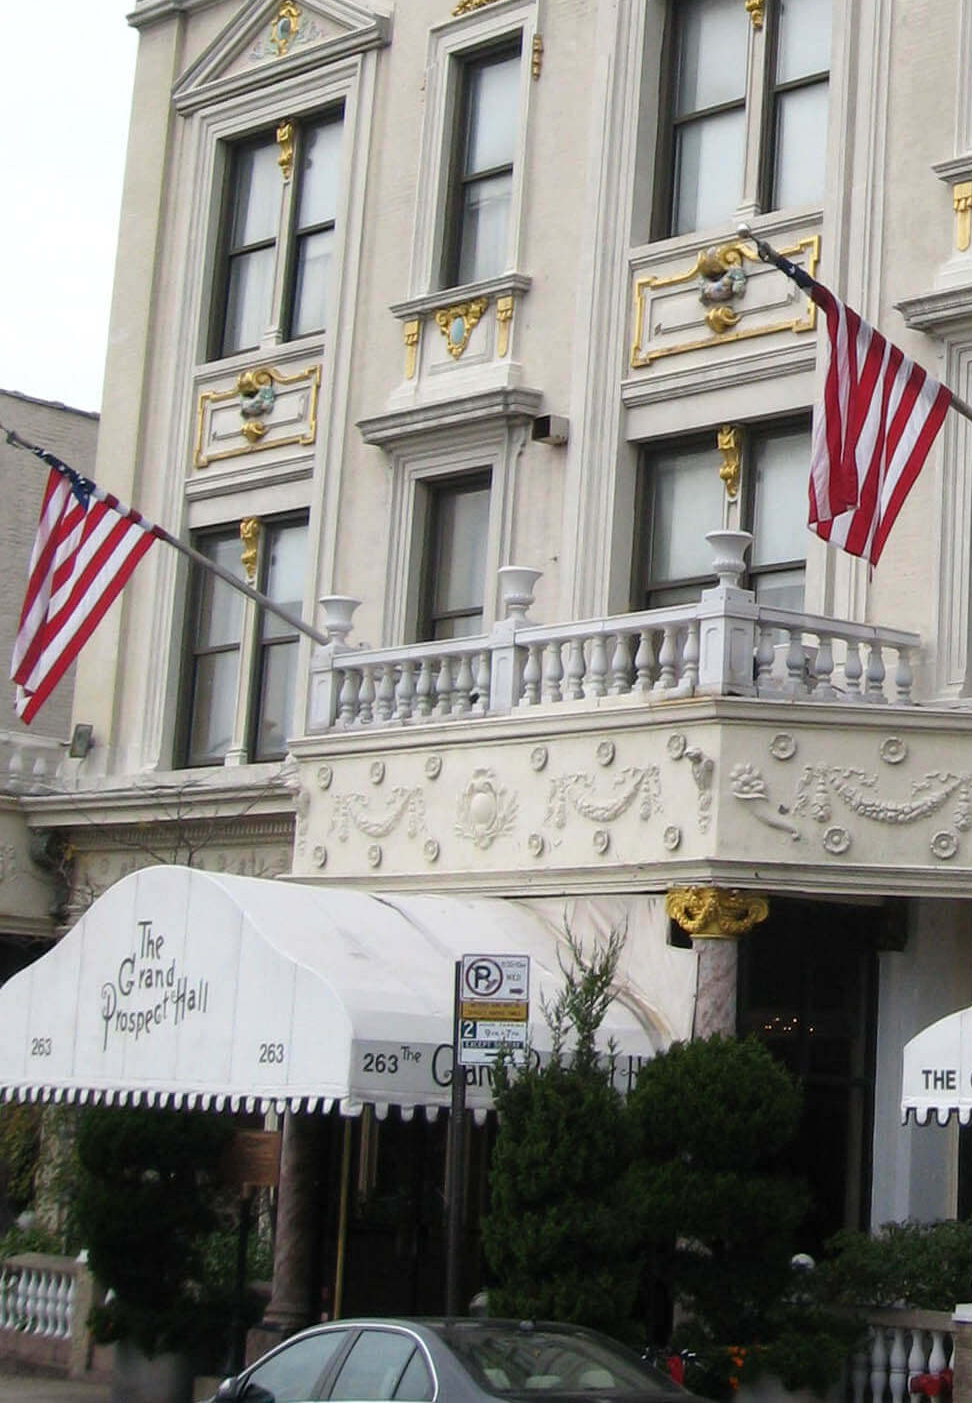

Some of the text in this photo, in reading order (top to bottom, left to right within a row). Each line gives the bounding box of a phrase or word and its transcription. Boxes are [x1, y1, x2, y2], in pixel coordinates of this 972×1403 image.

[137, 920, 165, 959] The
[118, 952, 176, 996] Grand
[101, 976, 209, 1052] Prospect Hall
[463, 1020, 474, 1037] 2
[31, 1037, 52, 1056] 263
[258, 1043, 285, 1064] 263
[362, 1052, 399, 1074] 263
[401, 1045, 422, 1064] The
[432, 1043, 497, 1087] Gan
[921, 1069, 957, 1091] THE
